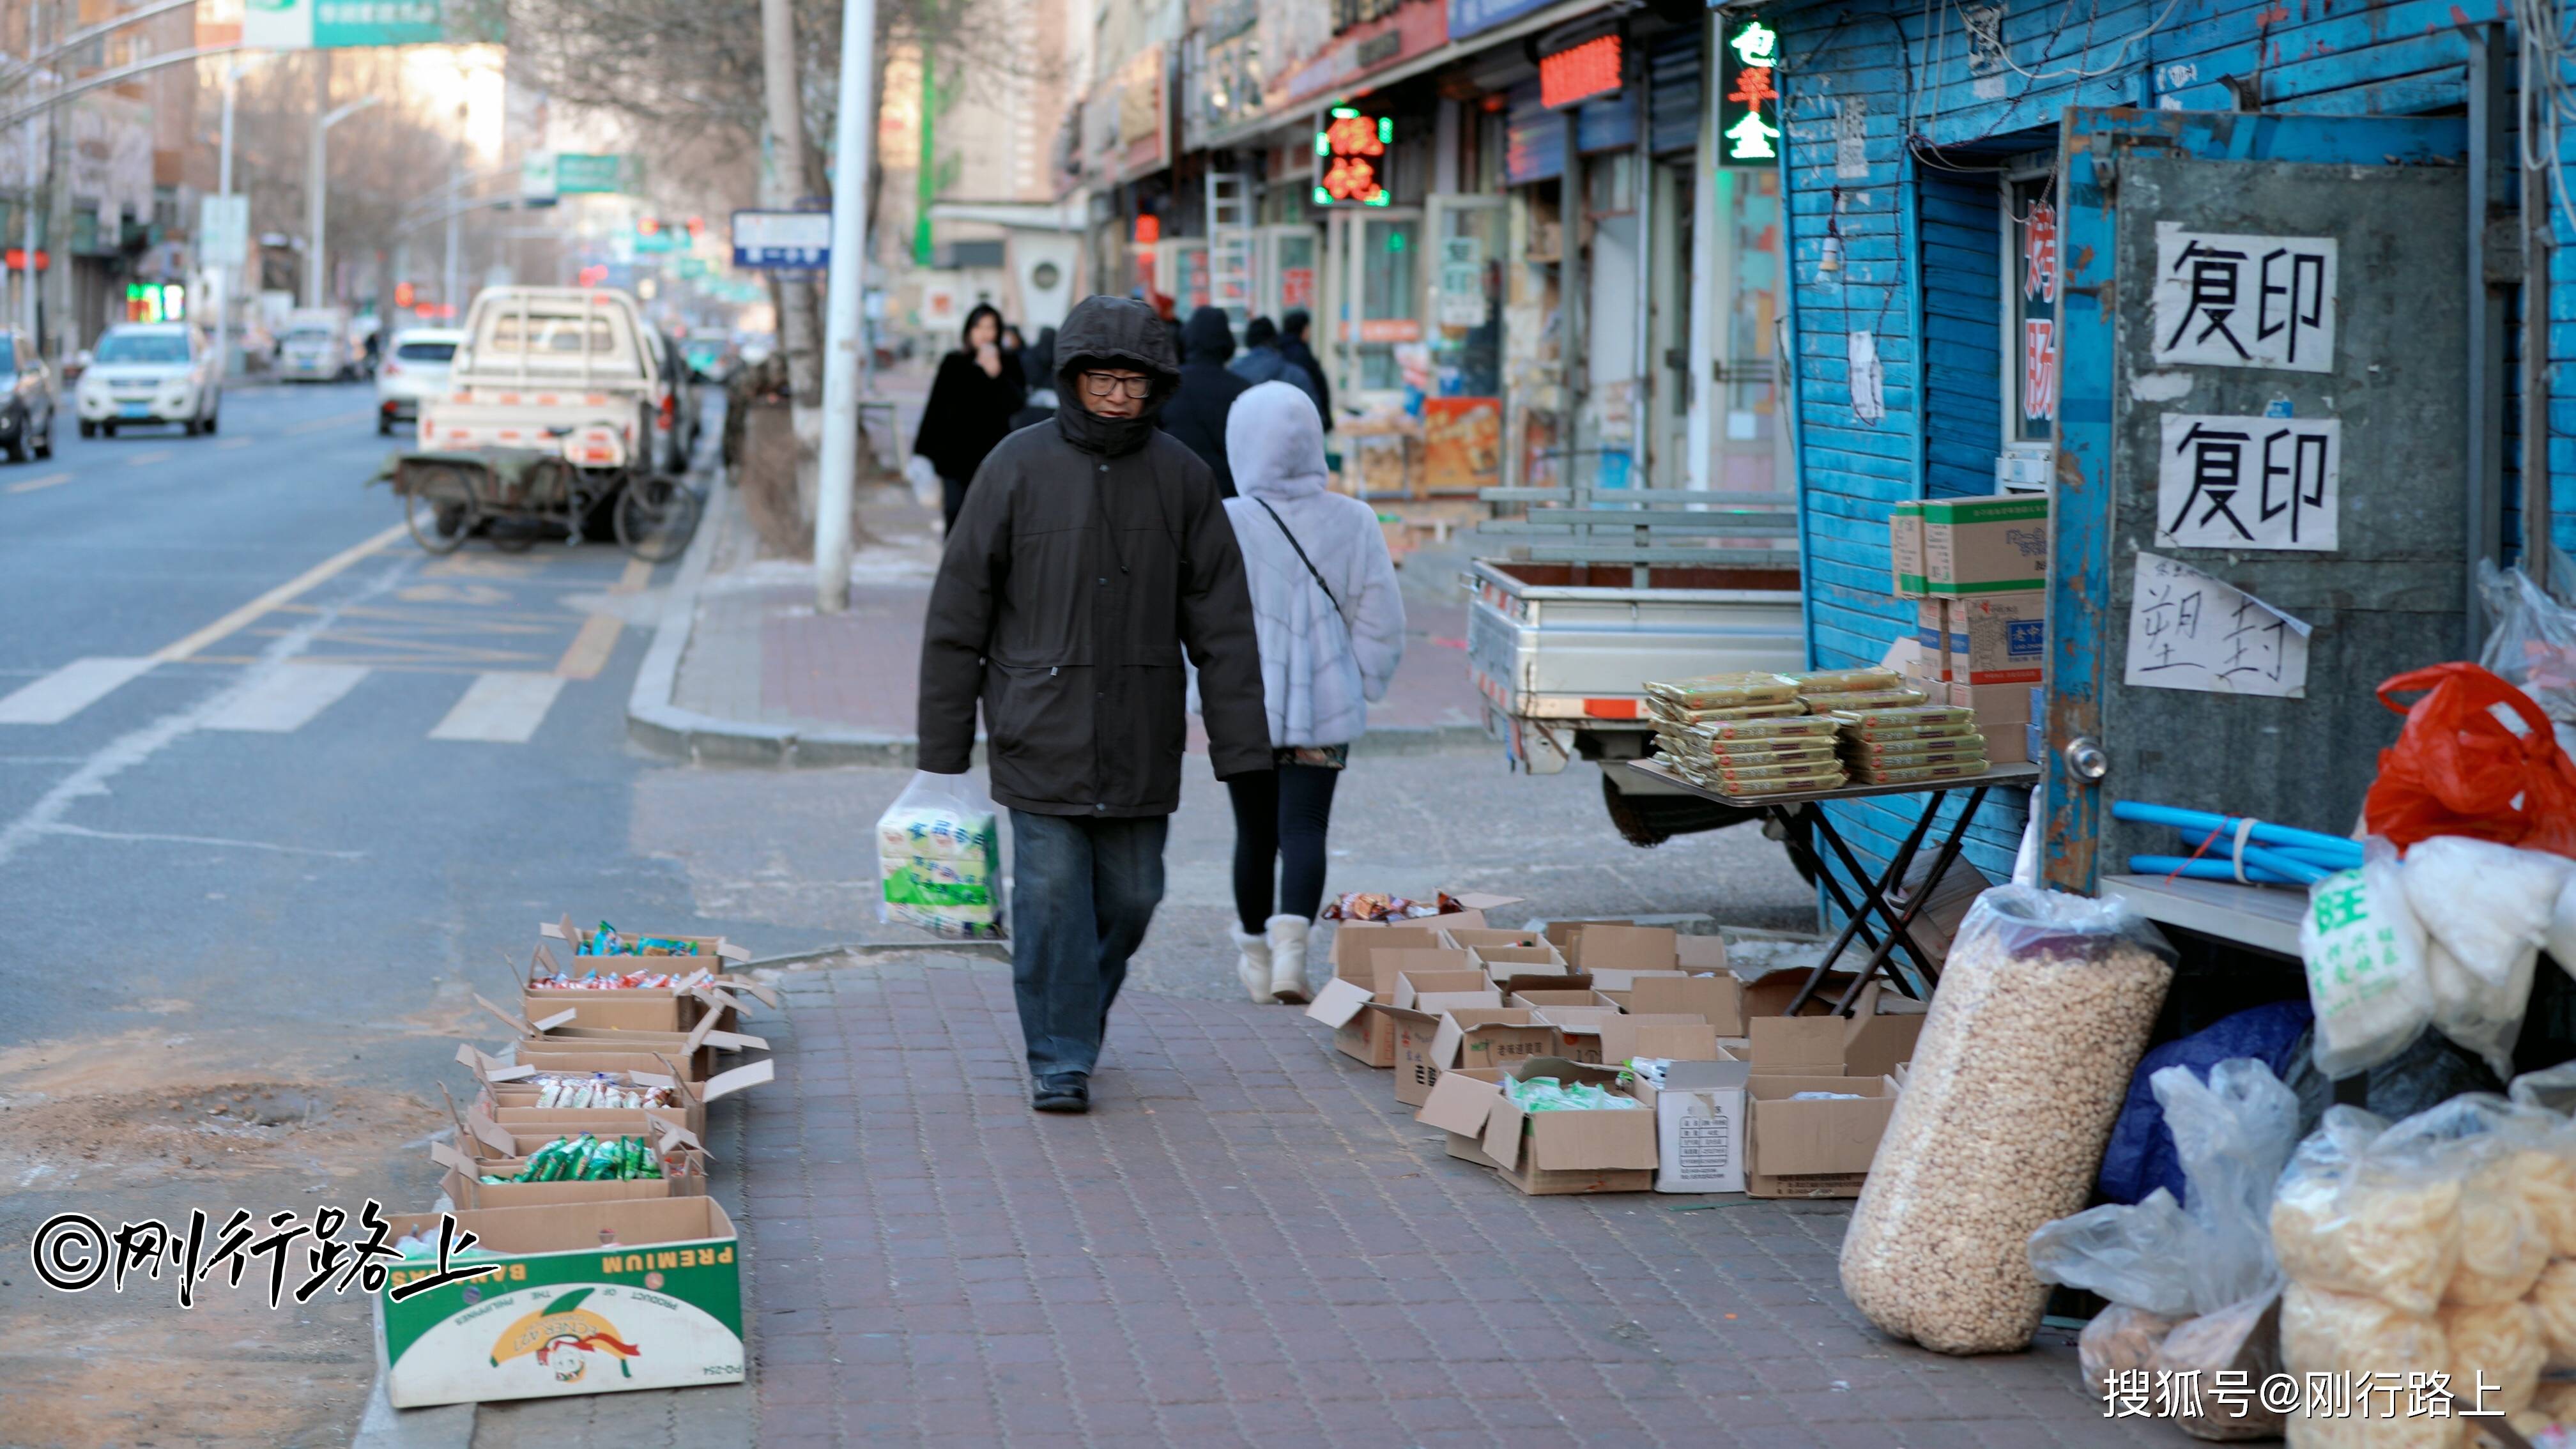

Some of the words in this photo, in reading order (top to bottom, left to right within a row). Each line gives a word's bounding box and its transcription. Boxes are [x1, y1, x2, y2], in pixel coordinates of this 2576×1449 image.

[2024, 199, 2056, 421] 烤肠
[2164, 239, 2327, 364] 复印
[2169, 422, 2329, 543] 复印
[2138, 583, 2287, 682] 塑封
[602, 1246, 733, 1274] PREMIUM
[530, 1290, 551, 1301] THE
[602, 1287, 617, 1296] OF
[630, 1291, 678, 1310] PRODUCT
[454, 1297, 515, 1327] PHILIPPINES
[702, 1364, 742, 1376] PQ-254
